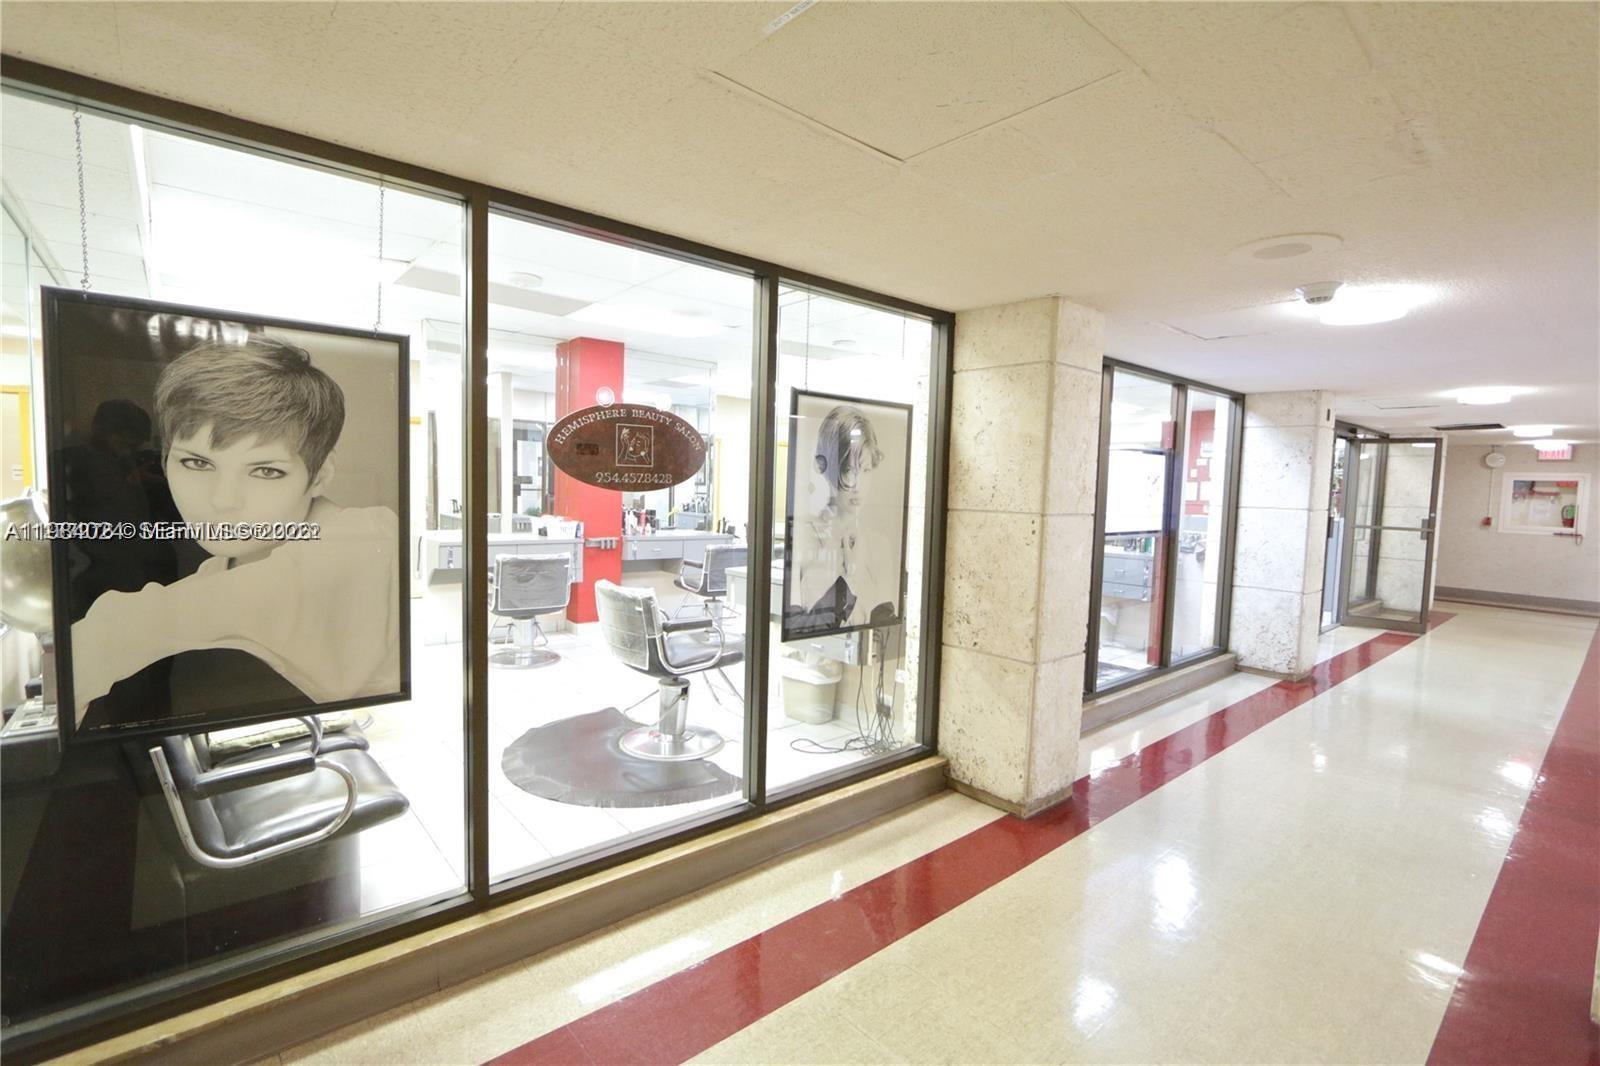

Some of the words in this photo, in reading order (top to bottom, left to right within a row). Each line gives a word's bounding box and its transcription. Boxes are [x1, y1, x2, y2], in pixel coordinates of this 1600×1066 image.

[554, 408, 627, 445] HEMISPHERE
[631, 409, 673, 426] BEAUTY
[674, 421, 702, 451] SALON
